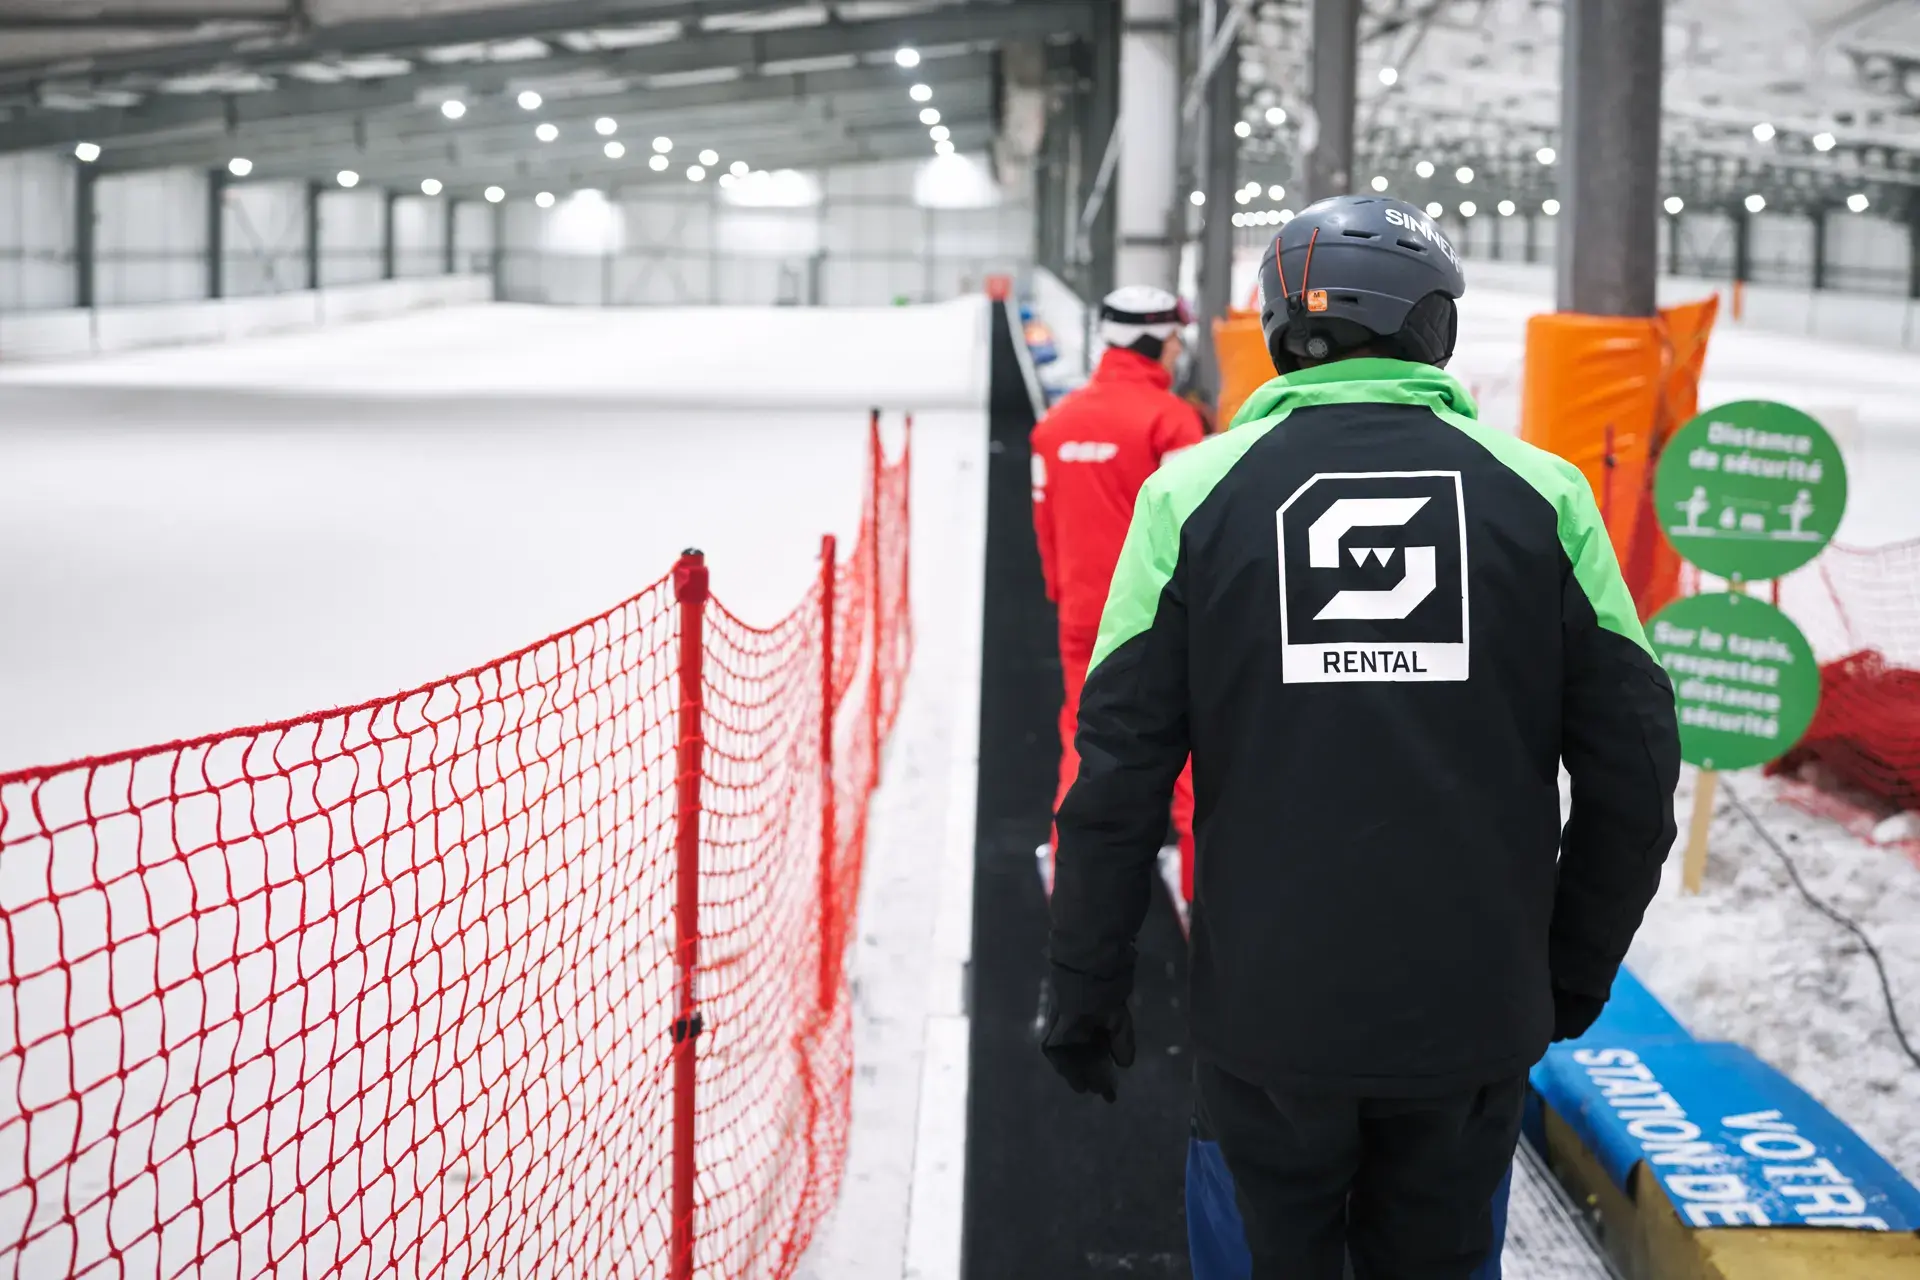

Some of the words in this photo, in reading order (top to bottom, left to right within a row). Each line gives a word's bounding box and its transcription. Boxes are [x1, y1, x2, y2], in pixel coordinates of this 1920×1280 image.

[1707, 421, 1812, 455] Distance
[1688, 446, 1719, 471] de
[1722, 450, 1823, 484] sécurité
[1654, 620, 1696, 648] Sur
[1699, 625, 1723, 651] le
[1323, 651, 1427, 673] RENTAL
[1661, 652, 1779, 687] respectez
[1679, 676, 1781, 713] distance
[1681, 704, 1779, 739] sécurité
[1573, 1048, 1722, 1167] STATION
[1664, 1173, 1771, 1228] DE
